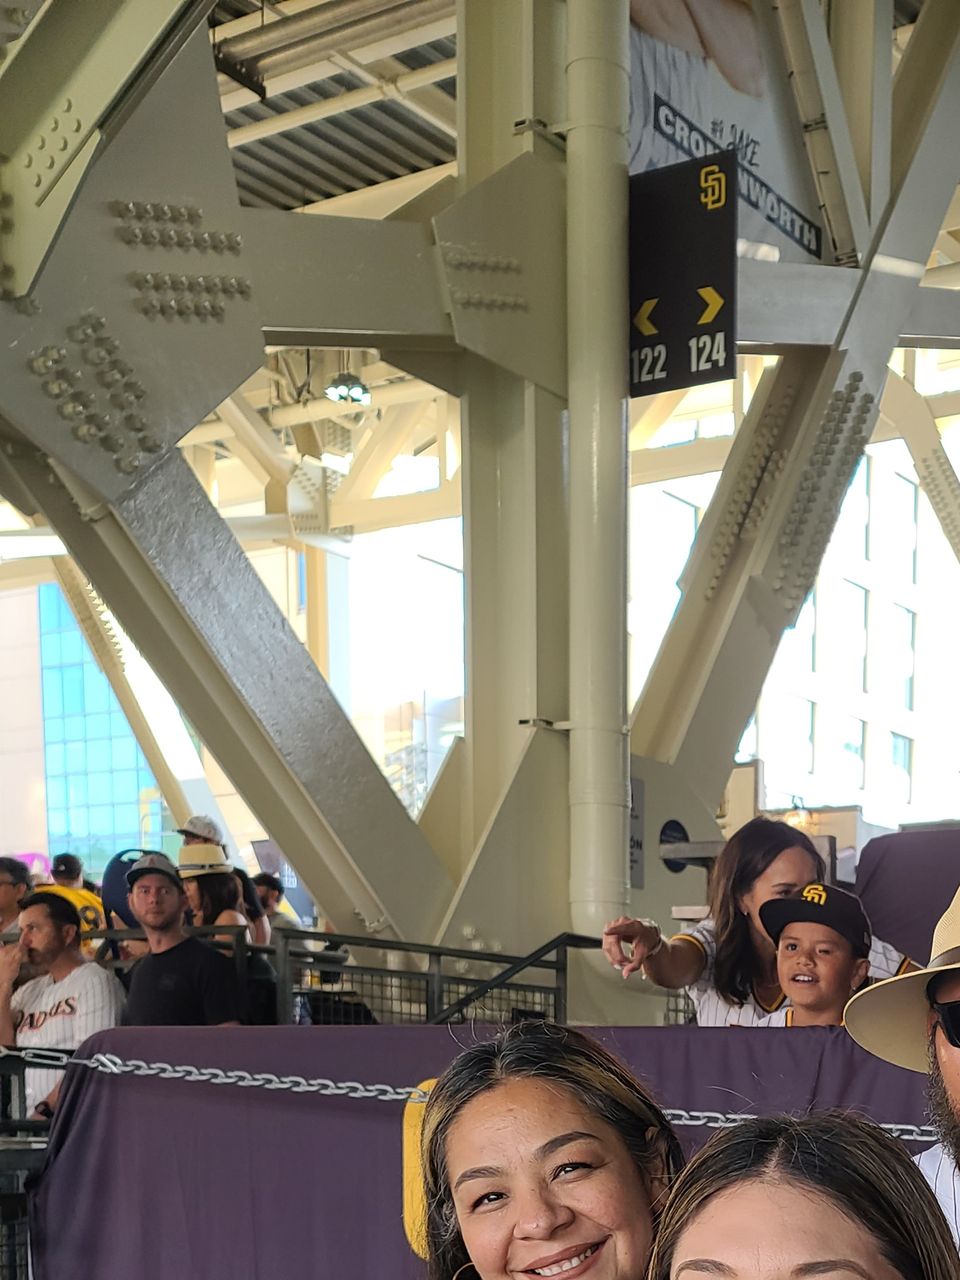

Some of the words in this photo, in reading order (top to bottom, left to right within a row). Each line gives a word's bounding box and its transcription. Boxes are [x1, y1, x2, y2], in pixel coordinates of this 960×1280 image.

[700, 165, 727, 210] SD
[632, 343, 668, 384] 122
[688, 331, 727, 373] 124
